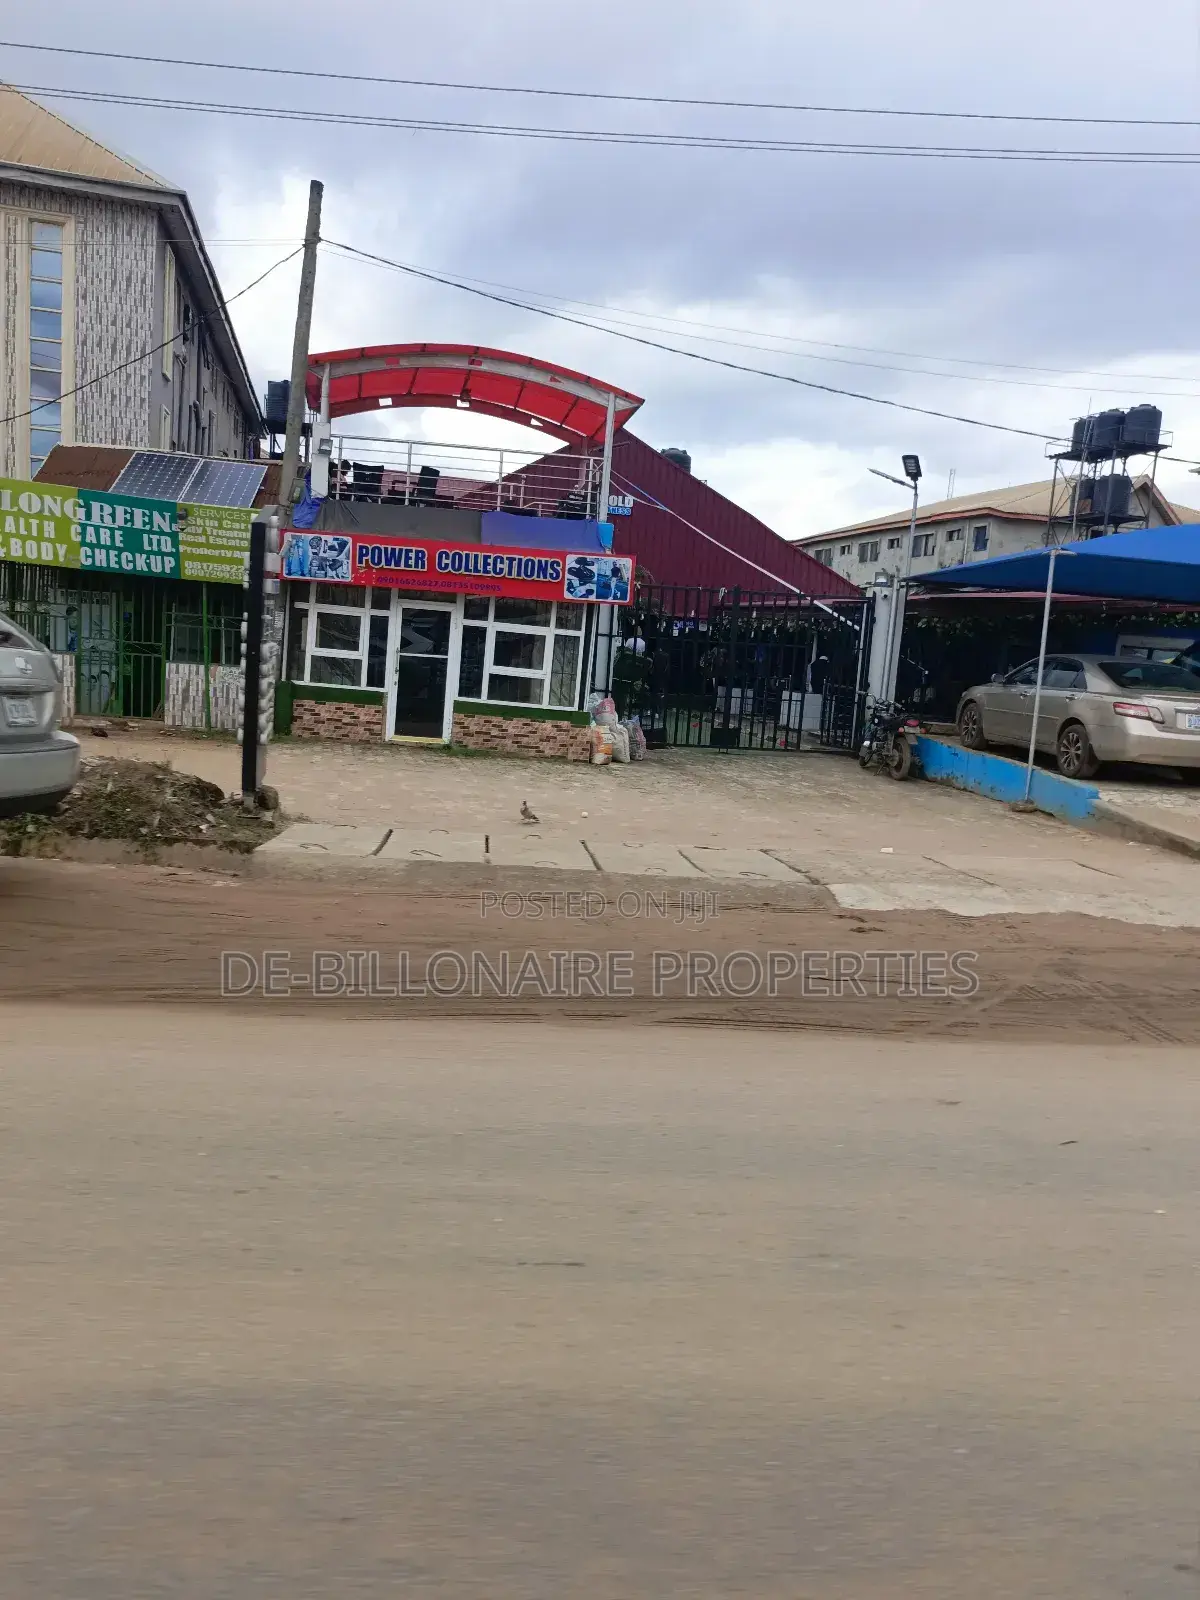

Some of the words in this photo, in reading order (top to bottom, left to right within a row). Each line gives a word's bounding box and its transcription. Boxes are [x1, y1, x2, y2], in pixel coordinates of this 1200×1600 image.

[0, 515, 56, 539] ALTH
[70, 524, 124, 548] CARE
[187, 516, 219, 527] Skin
[222, 520, 250, 531] Car
[178, 533, 207, 544] Real
[208, 536, 249, 547] Estate
[357, 543, 428, 571] POWER
[436, 549, 563, 582] COLLECTIONS
